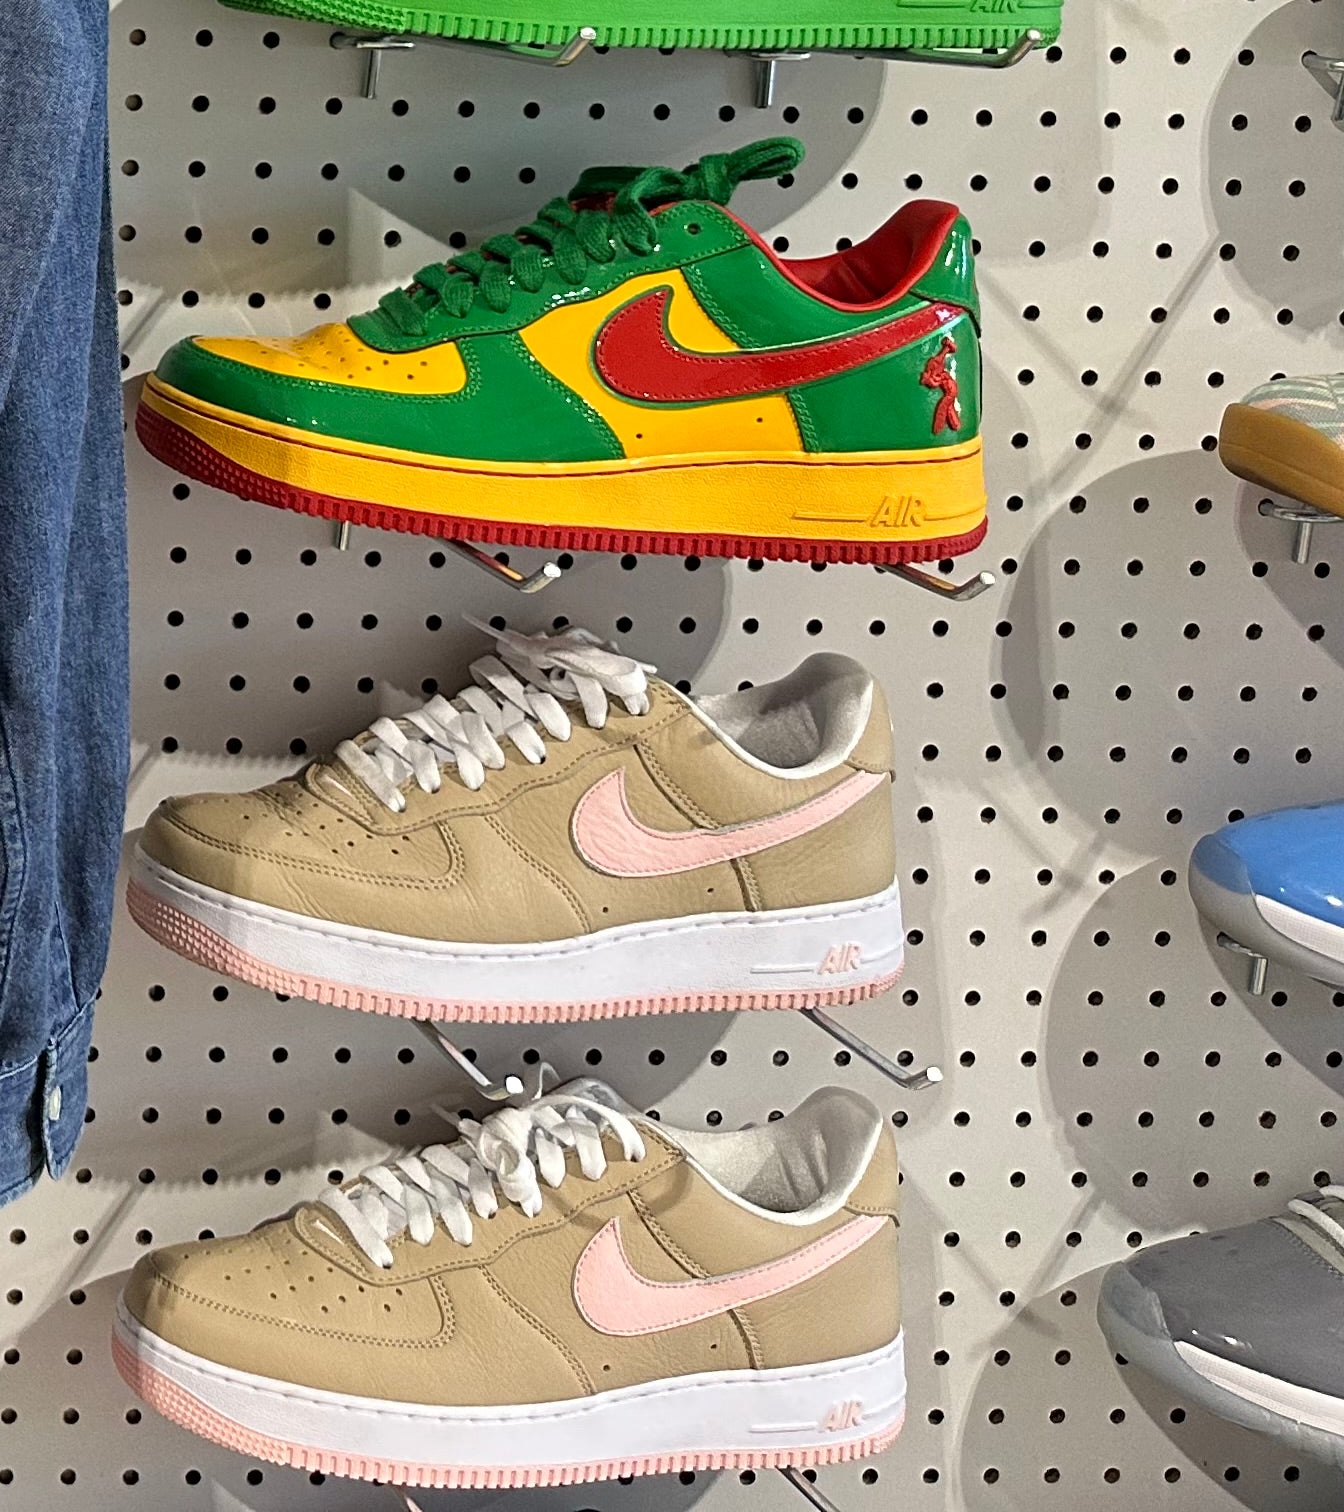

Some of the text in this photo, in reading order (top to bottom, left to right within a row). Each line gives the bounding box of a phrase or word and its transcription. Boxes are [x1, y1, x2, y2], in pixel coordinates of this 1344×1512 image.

[869, 495, 924, 528] AIR
[817, 941, 863, 975] AIR
[818, 1398, 863, 1433] AIR
